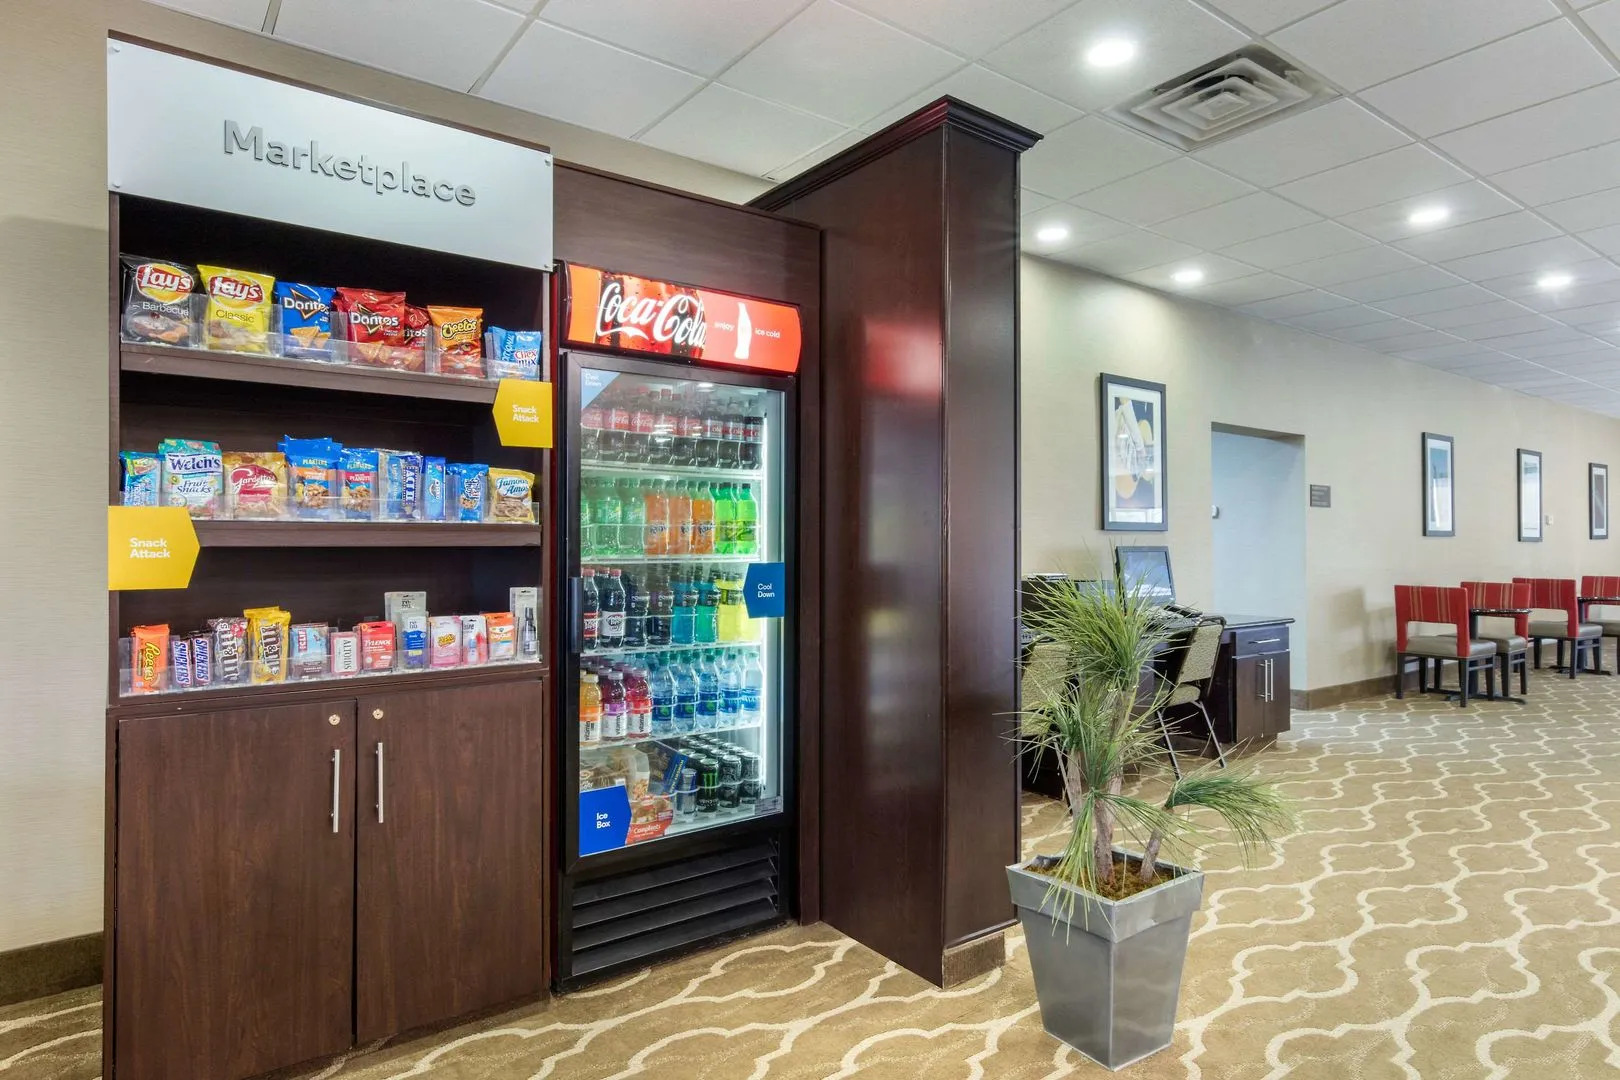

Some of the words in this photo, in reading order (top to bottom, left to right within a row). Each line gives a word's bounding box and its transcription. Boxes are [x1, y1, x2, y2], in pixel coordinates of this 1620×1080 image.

[223, 119, 477, 207] Marketplace
[139, 264, 192, 291] Lay's
[142, 301, 190, 316] Barbecue
[284, 296, 330, 315] Doritos
[215, 309, 255, 323] Classic
[350, 311, 399, 326] Doritos
[596, 282, 706, 347] Coca-Cola
[442, 319, 477, 338] Cheetos
[714, 321, 735, 331] enjoy
[754, 328, 765, 336] ice
[765, 329, 781, 338] cold
[514, 349, 537, 360] Chex
[512, 405, 537, 414] Snack
[512, 414, 539, 423] Attack
[169, 456, 221, 471] Welch's
[183, 480, 208, 489] Fruit
[406, 469, 415, 489] ACT
[496, 478, 529, 490] Famous
[176, 485, 211, 494] Snacks
[506, 486, 528, 496] Amos
[129, 538, 168, 548] Snack
[129, 548, 170, 559] Attack
[757, 583, 773, 591] Cool
[757, 591, 775, 599] Down
[299, 631, 307, 649] CLIF
[363, 639, 392, 647] TYLENOL
[195, 639, 209, 680] SNICKERS
[343, 639, 352, 670] ALTOIDS
[144, 642, 161, 681] Reese's
[174, 642, 189, 683] SNICKERS
[596, 812, 608, 821] Ice
[596, 820, 611, 829] Box
